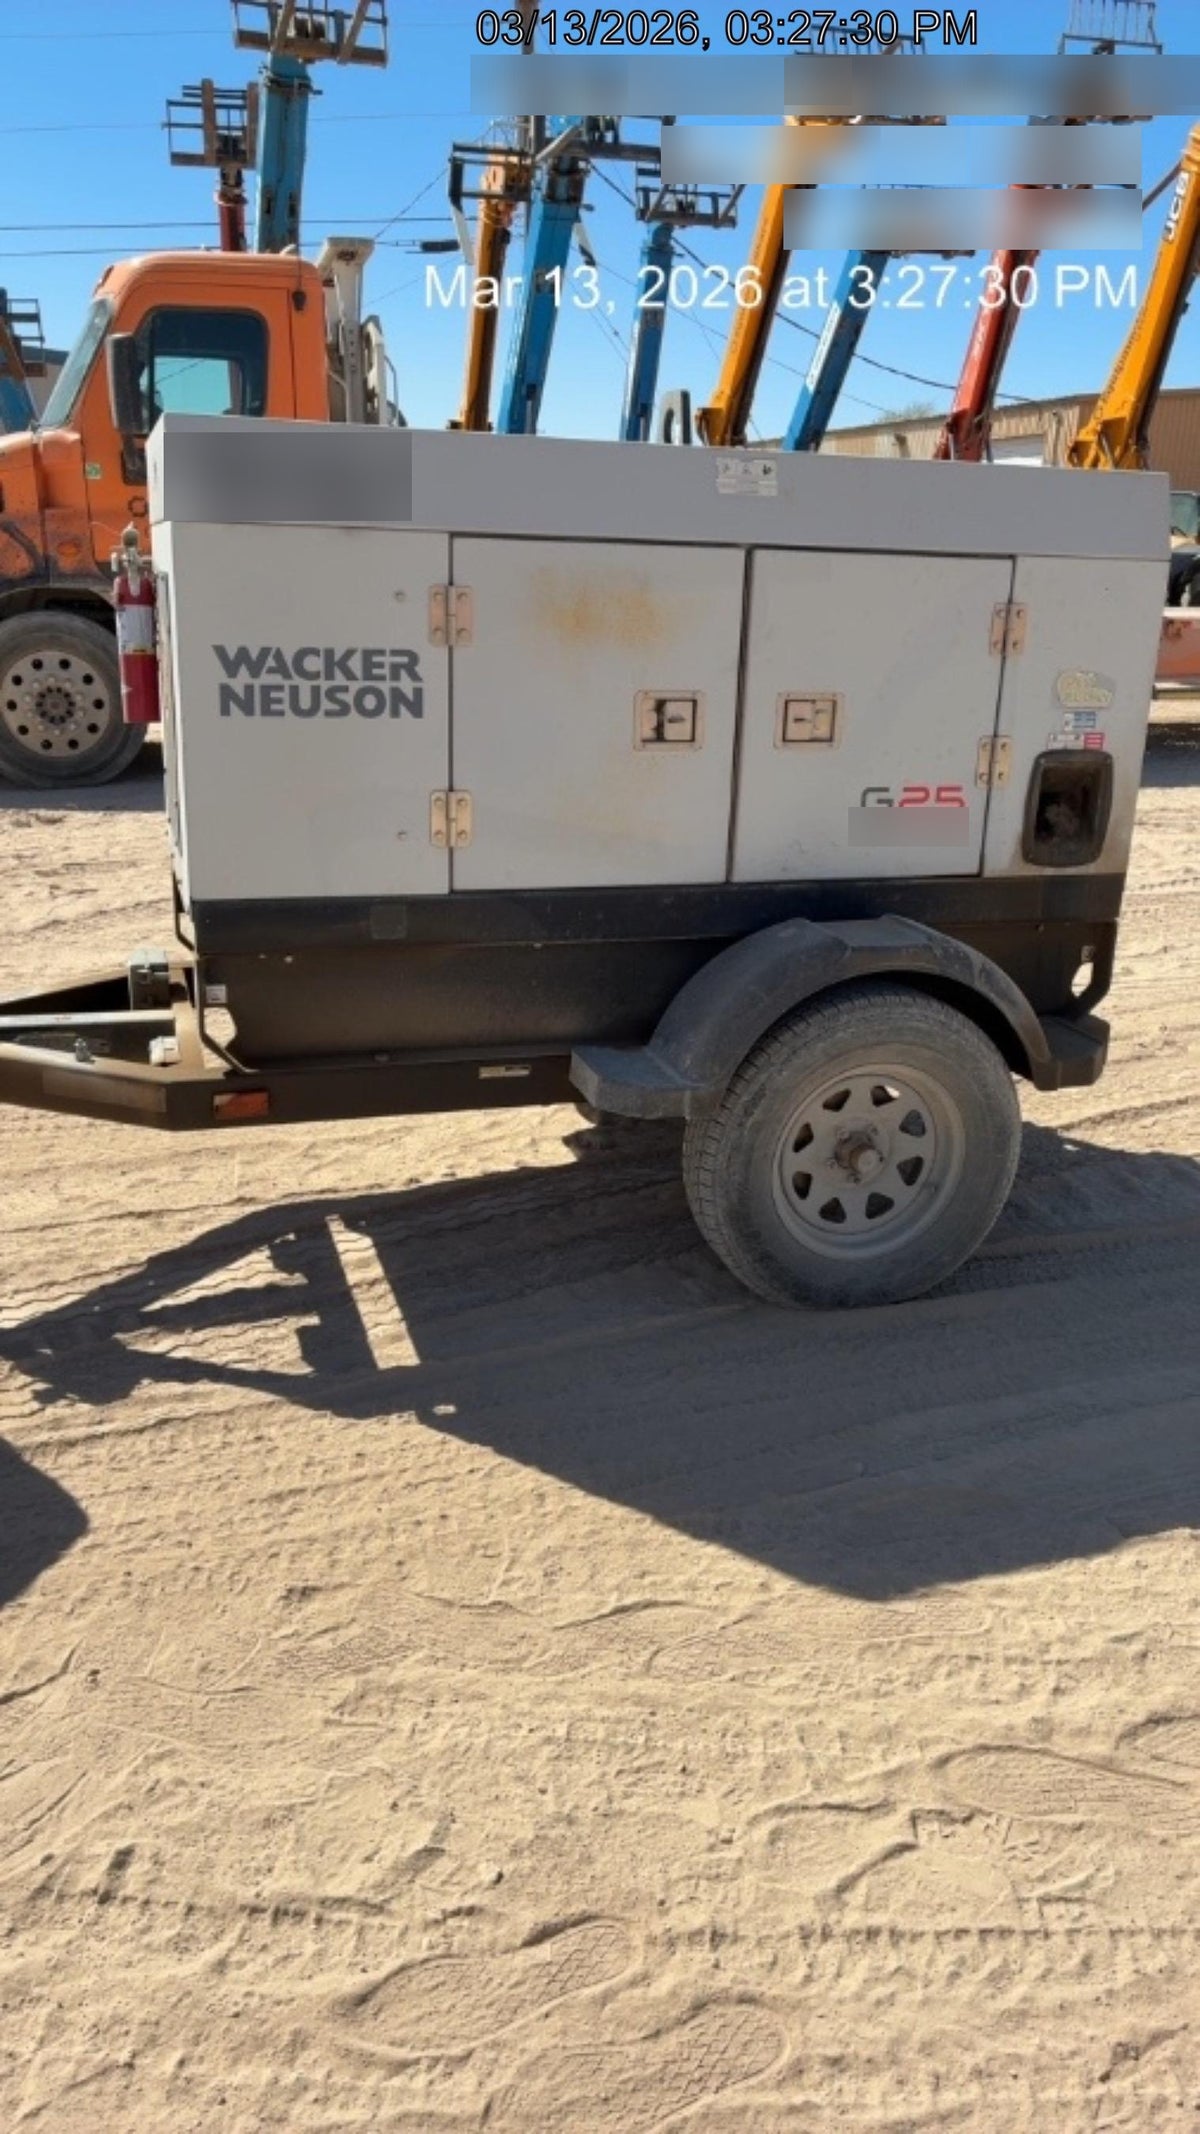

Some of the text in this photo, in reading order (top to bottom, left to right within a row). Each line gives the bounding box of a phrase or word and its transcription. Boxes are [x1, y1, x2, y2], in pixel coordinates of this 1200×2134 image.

[1163, 170, 1190, 243] JCB
[211, 644, 423, 682] WACKER
[219, 683, 424, 719] NEUSON
